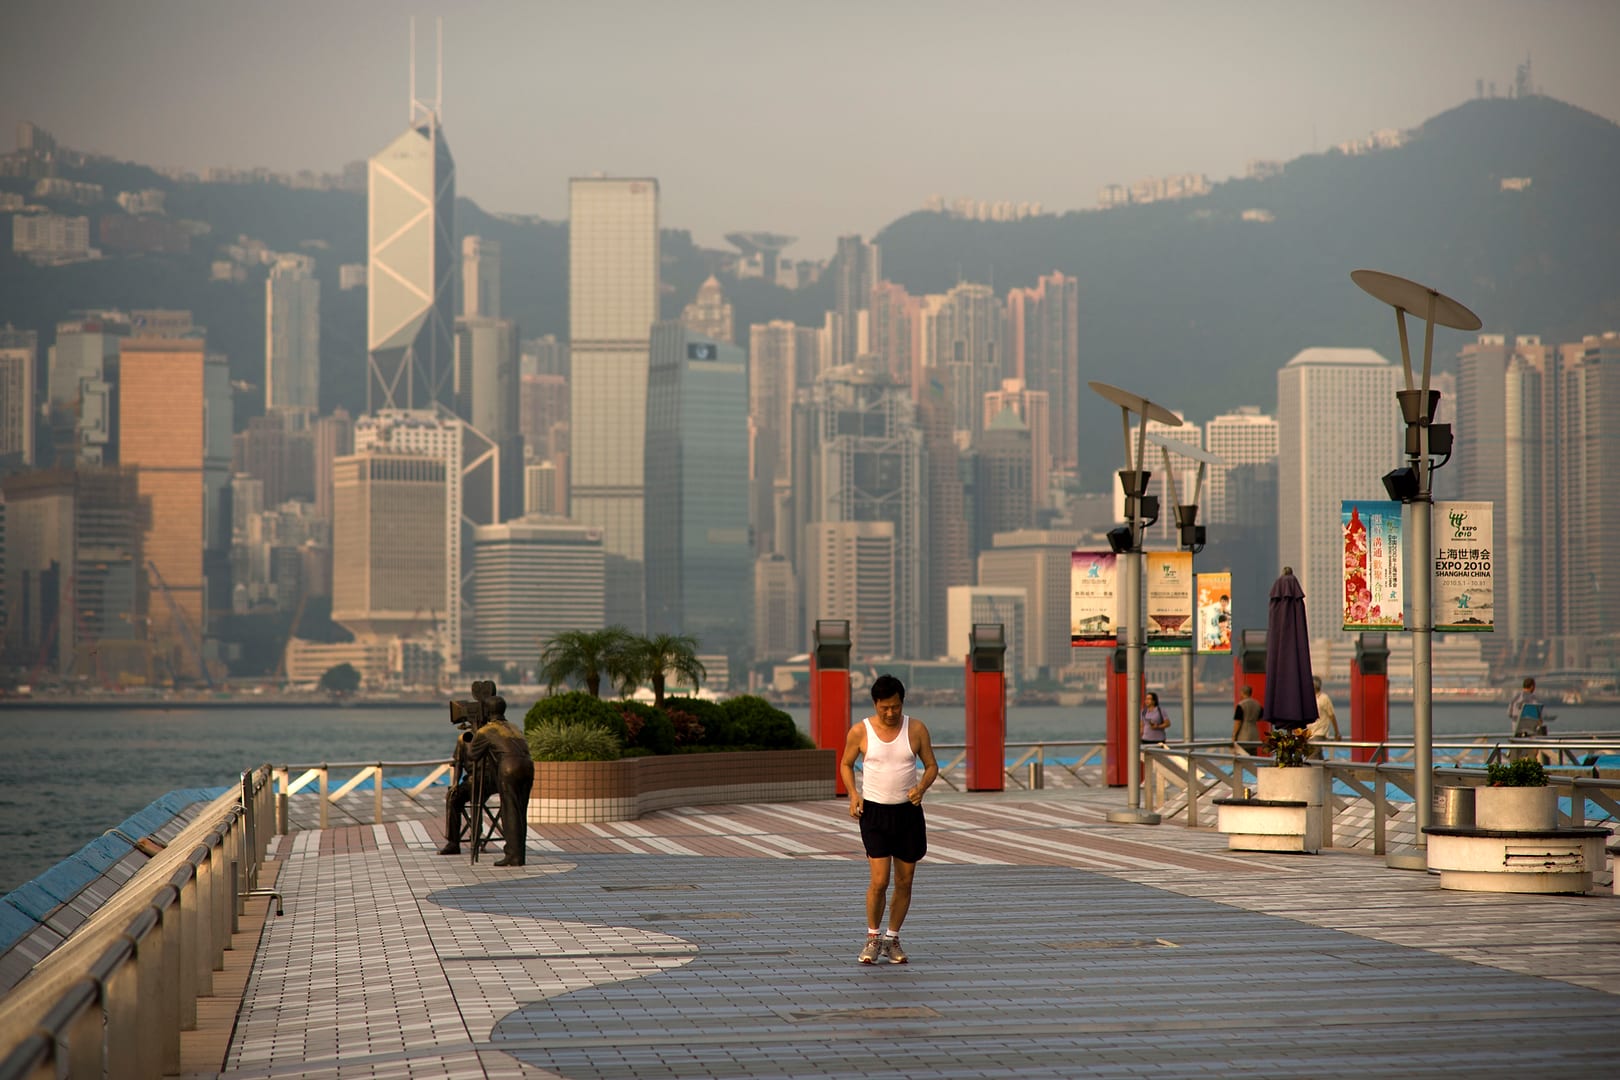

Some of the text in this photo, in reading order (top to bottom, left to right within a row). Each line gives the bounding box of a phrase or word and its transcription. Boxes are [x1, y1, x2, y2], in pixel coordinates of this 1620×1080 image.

[1435, 548, 1491, 560] 上海世博会
[1435, 561, 1491, 571] EXPO 2010
